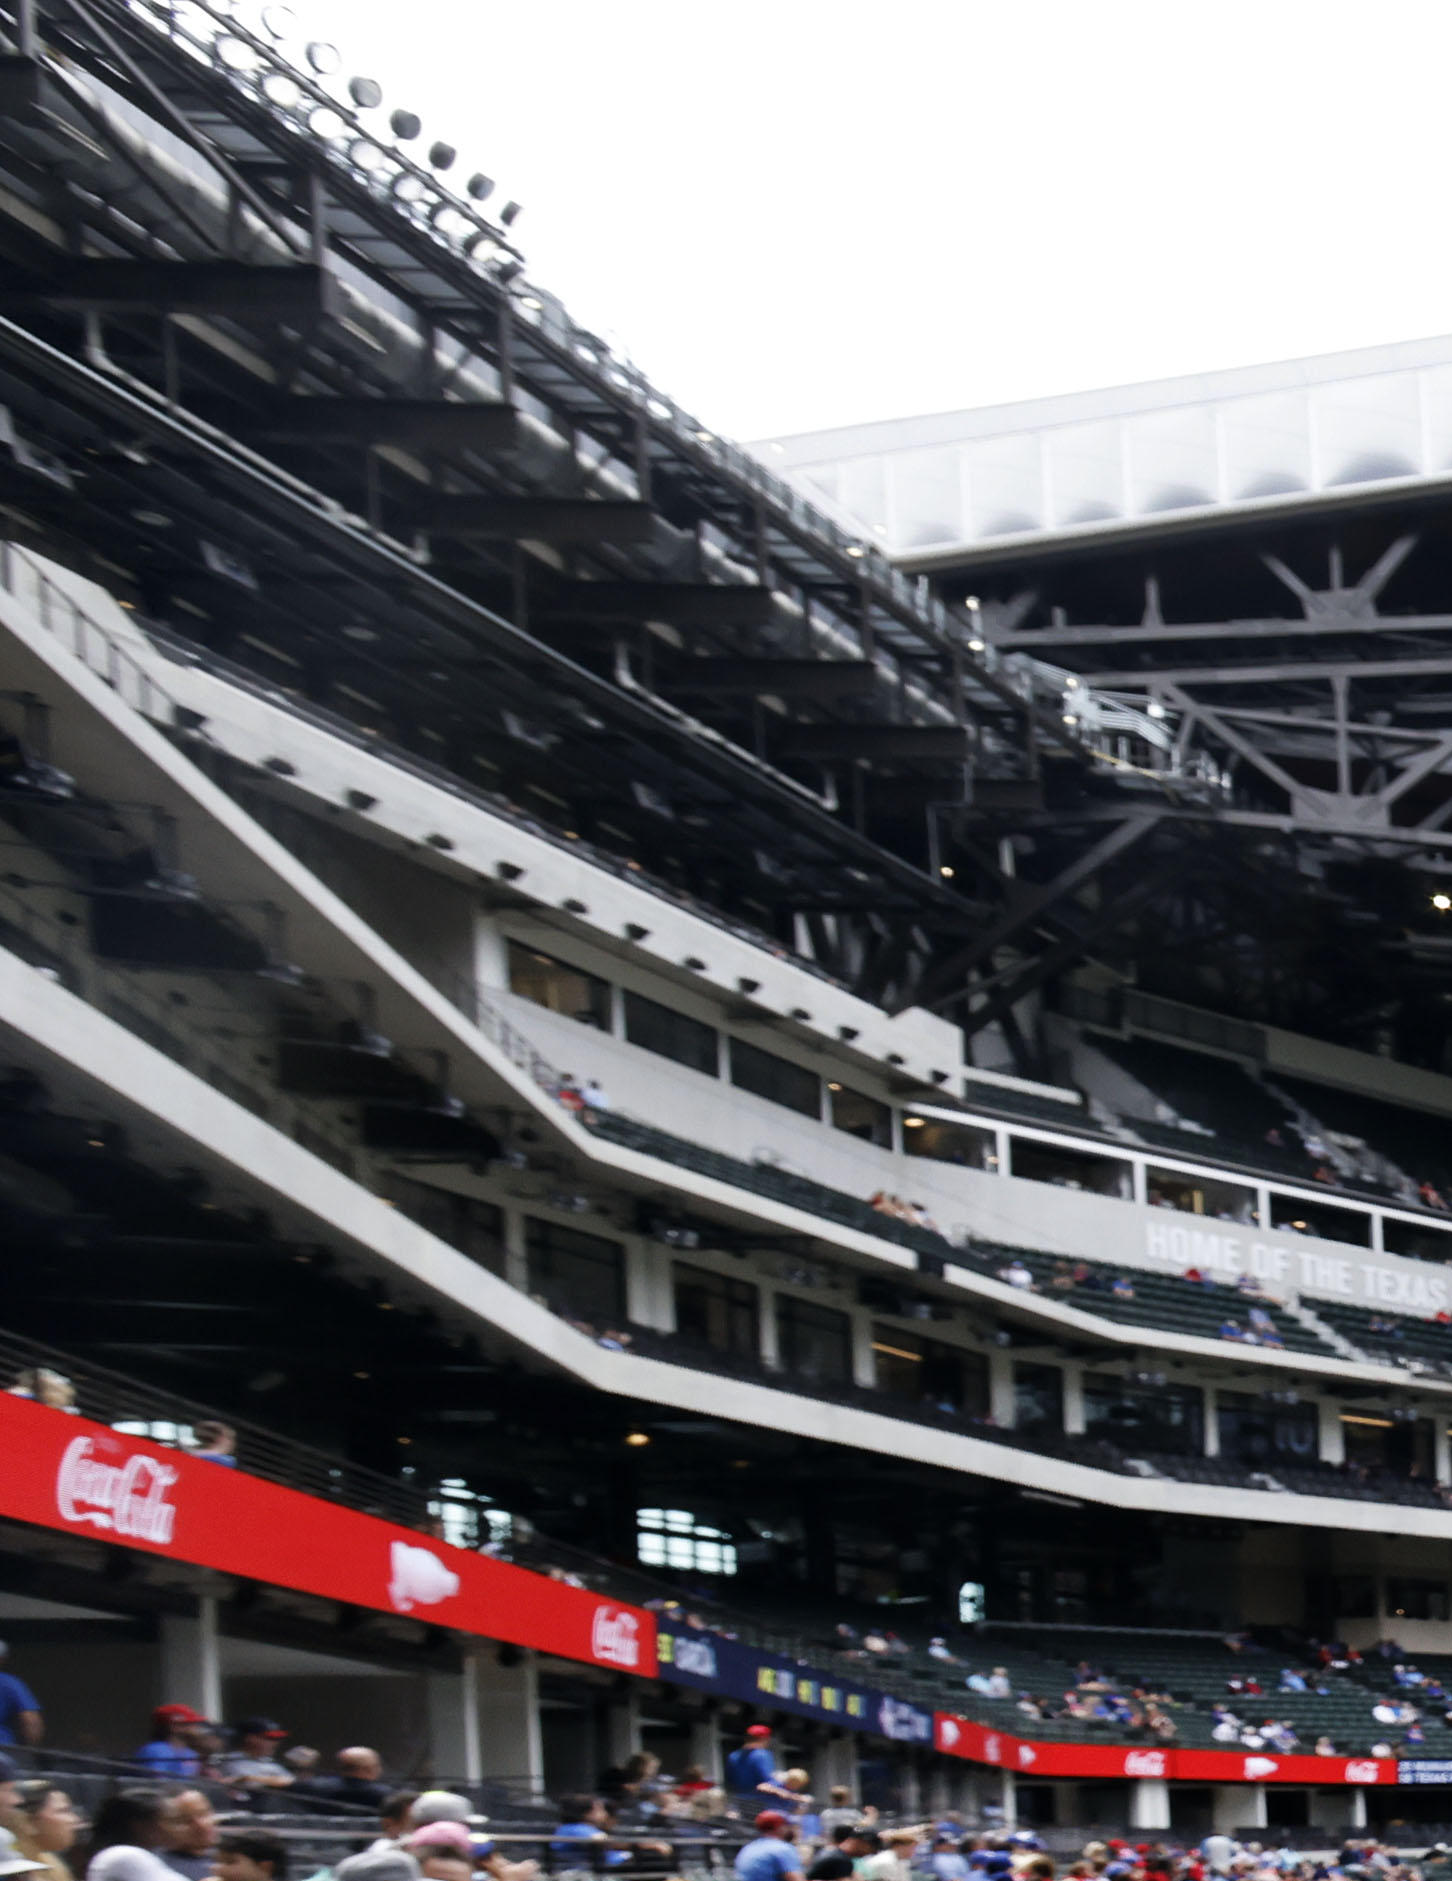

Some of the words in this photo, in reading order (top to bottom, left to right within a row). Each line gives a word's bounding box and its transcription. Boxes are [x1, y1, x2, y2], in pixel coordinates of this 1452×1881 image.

[1145, 1221, 1241, 1272] HOME
[1251, 1242, 1292, 1282] OF
[1298, 1251, 1353, 1293] THE
[1360, 1264, 1447, 1310] TEXAS
[57, 1435, 180, 1545] Coca-Cola
